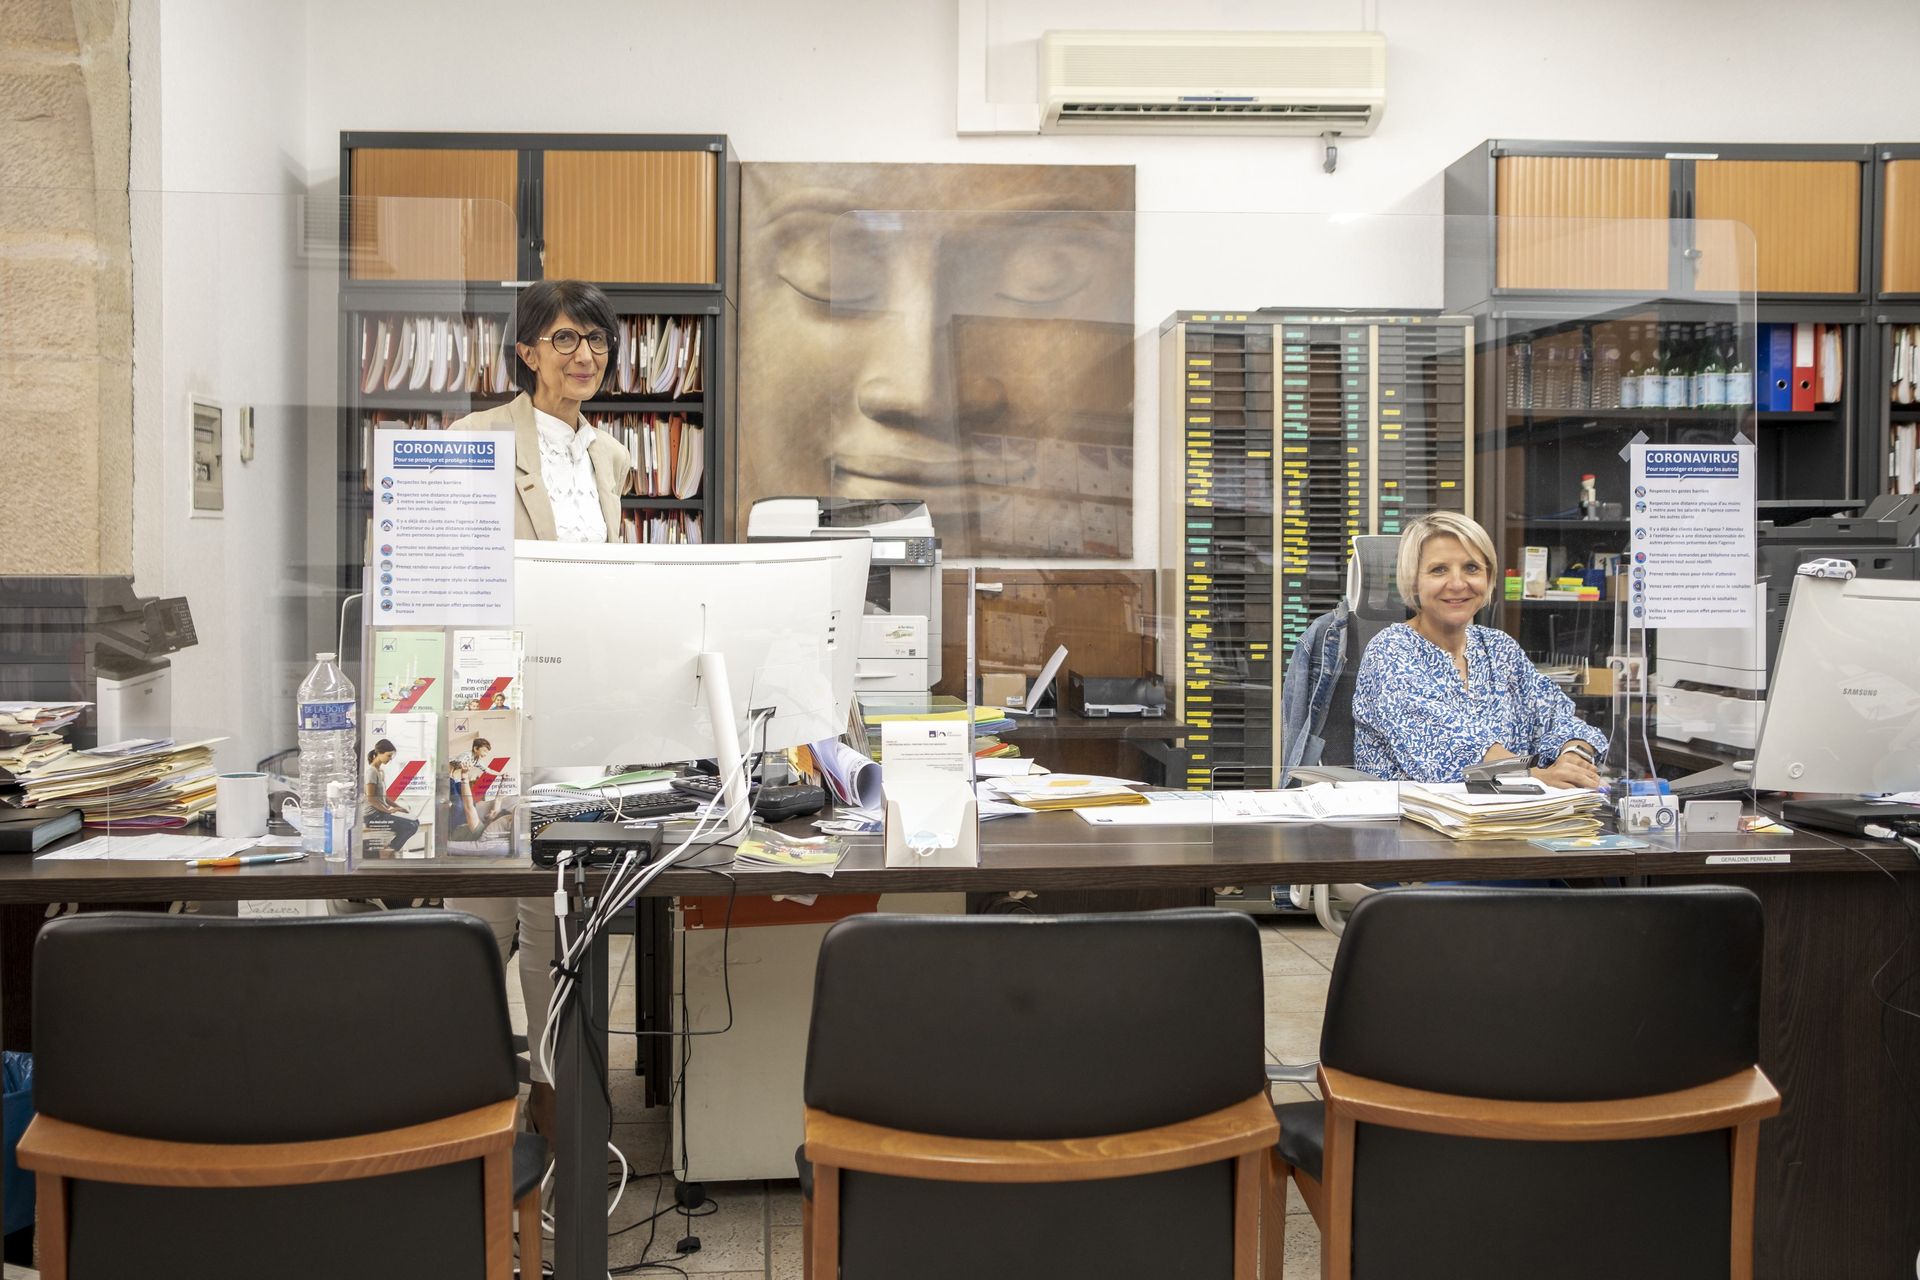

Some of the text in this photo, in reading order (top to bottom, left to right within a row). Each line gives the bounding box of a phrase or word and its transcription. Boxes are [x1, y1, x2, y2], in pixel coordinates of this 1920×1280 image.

[395, 443, 494, 455] CORONAVIRUS
[1647, 452, 1738, 464] CORONAVIRUS
[1843, 688, 1877, 696] SAMSUNG
